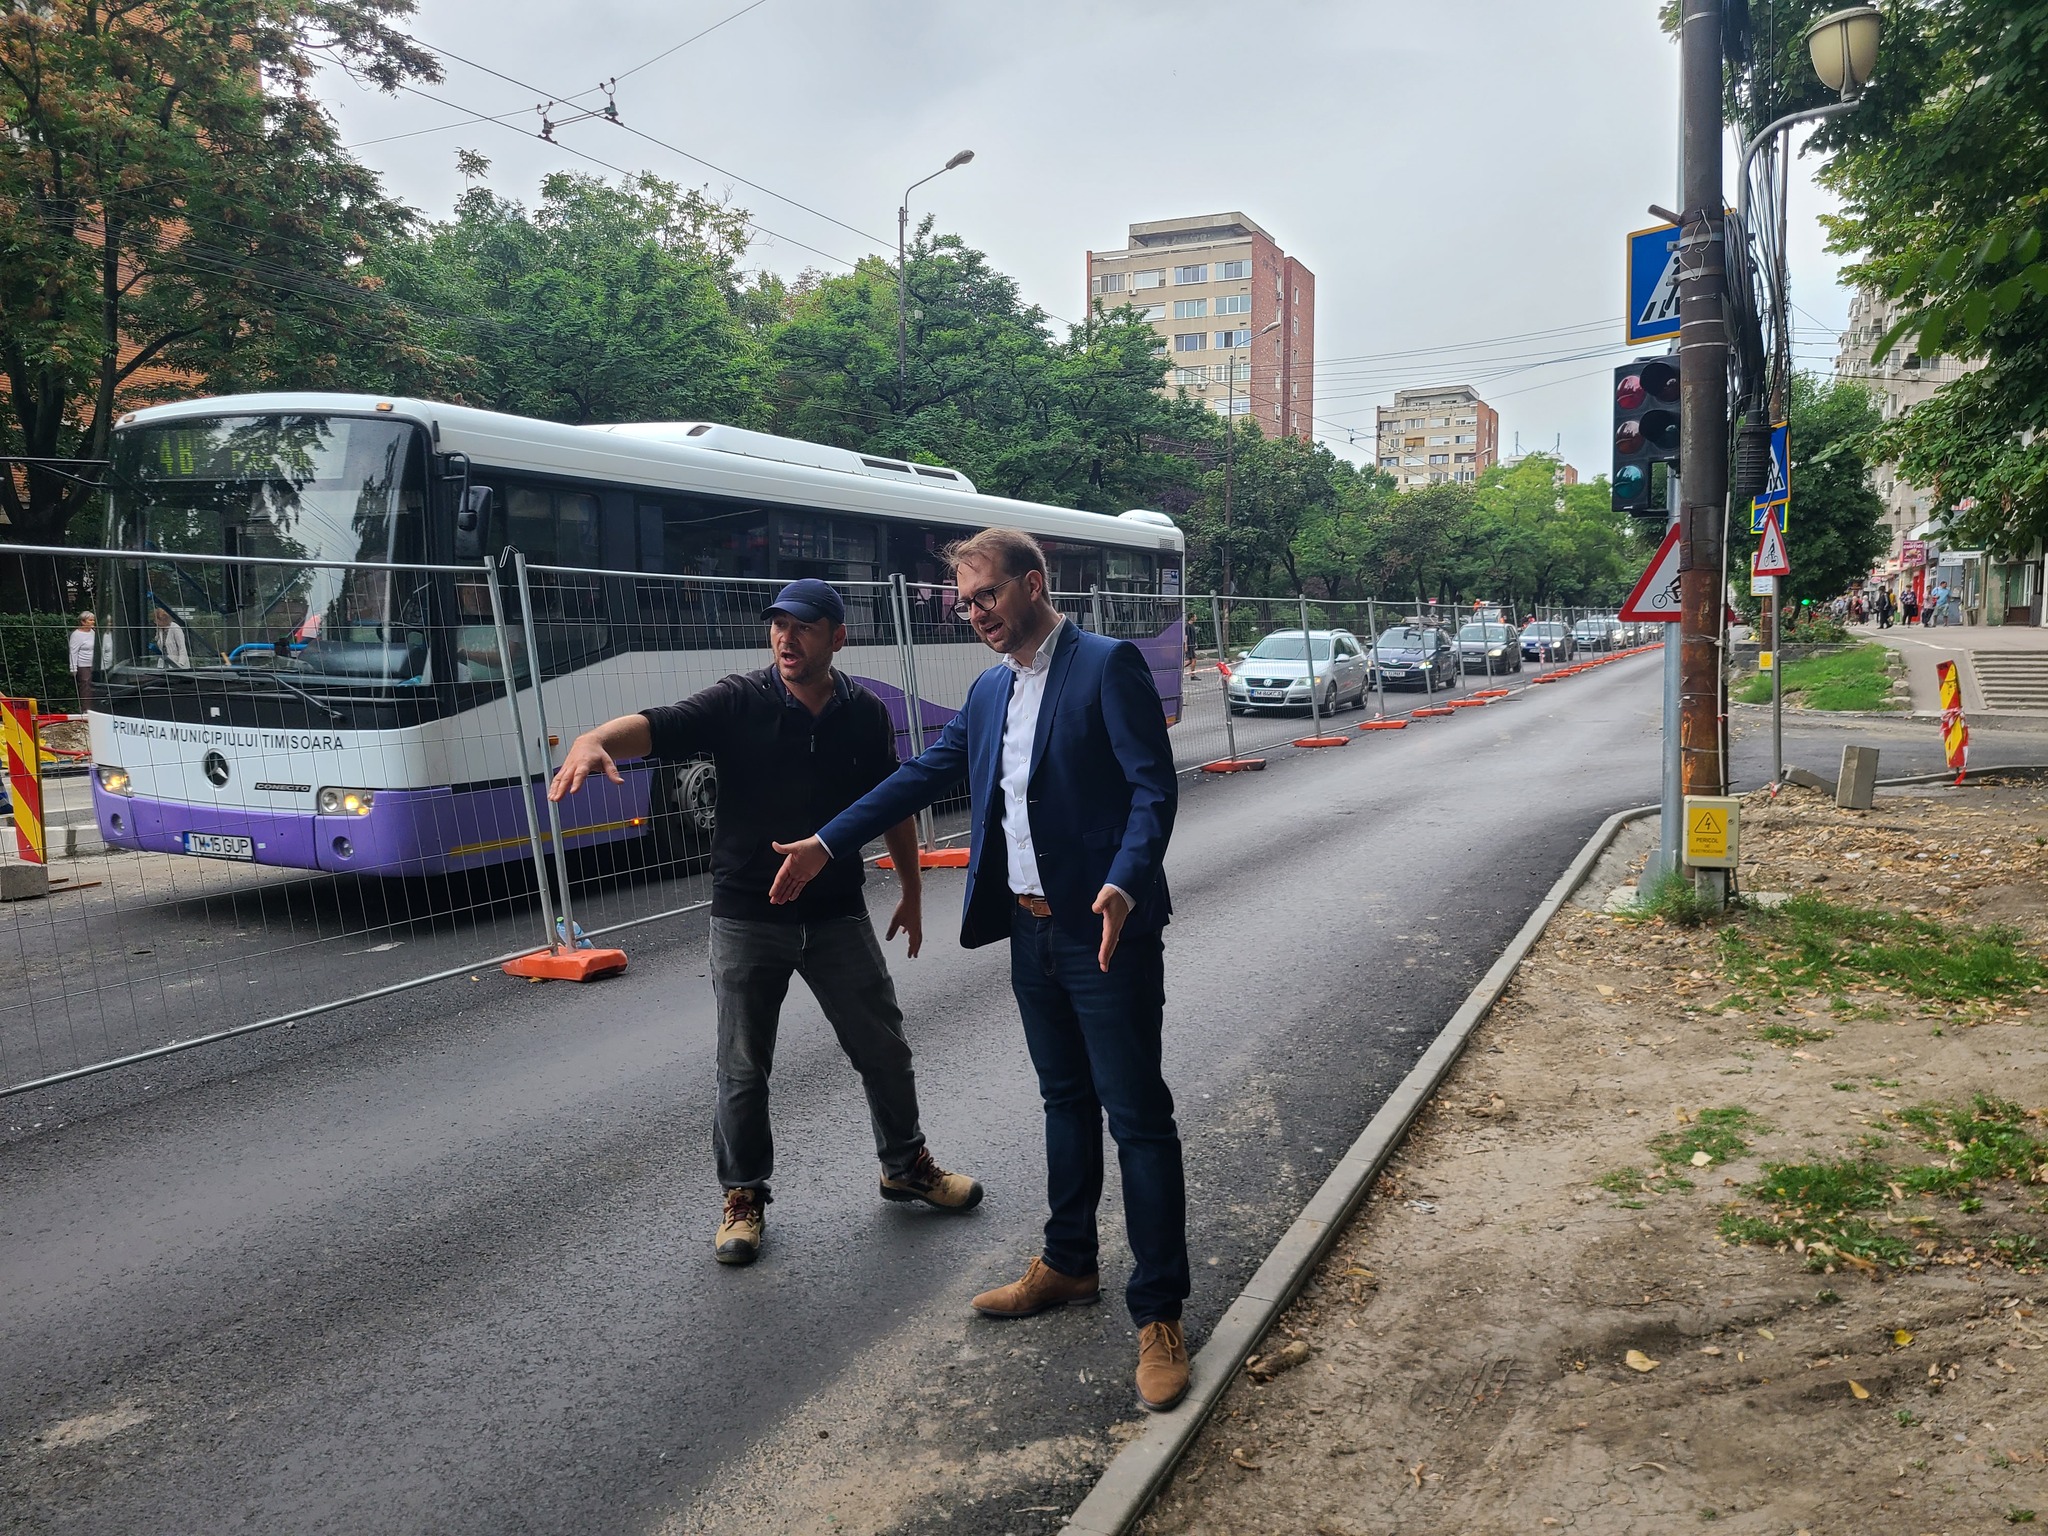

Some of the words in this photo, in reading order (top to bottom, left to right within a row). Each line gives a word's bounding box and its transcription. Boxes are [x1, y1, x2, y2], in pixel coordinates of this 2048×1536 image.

[113, 720, 168, 741] PRIMARIA
[170, 727, 258, 748] MUNICIPIULUI
[262, 734, 344, 750] TIMISOARA
[256, 783, 310, 792] CONECTO
[223, 838, 249, 854] GUP
